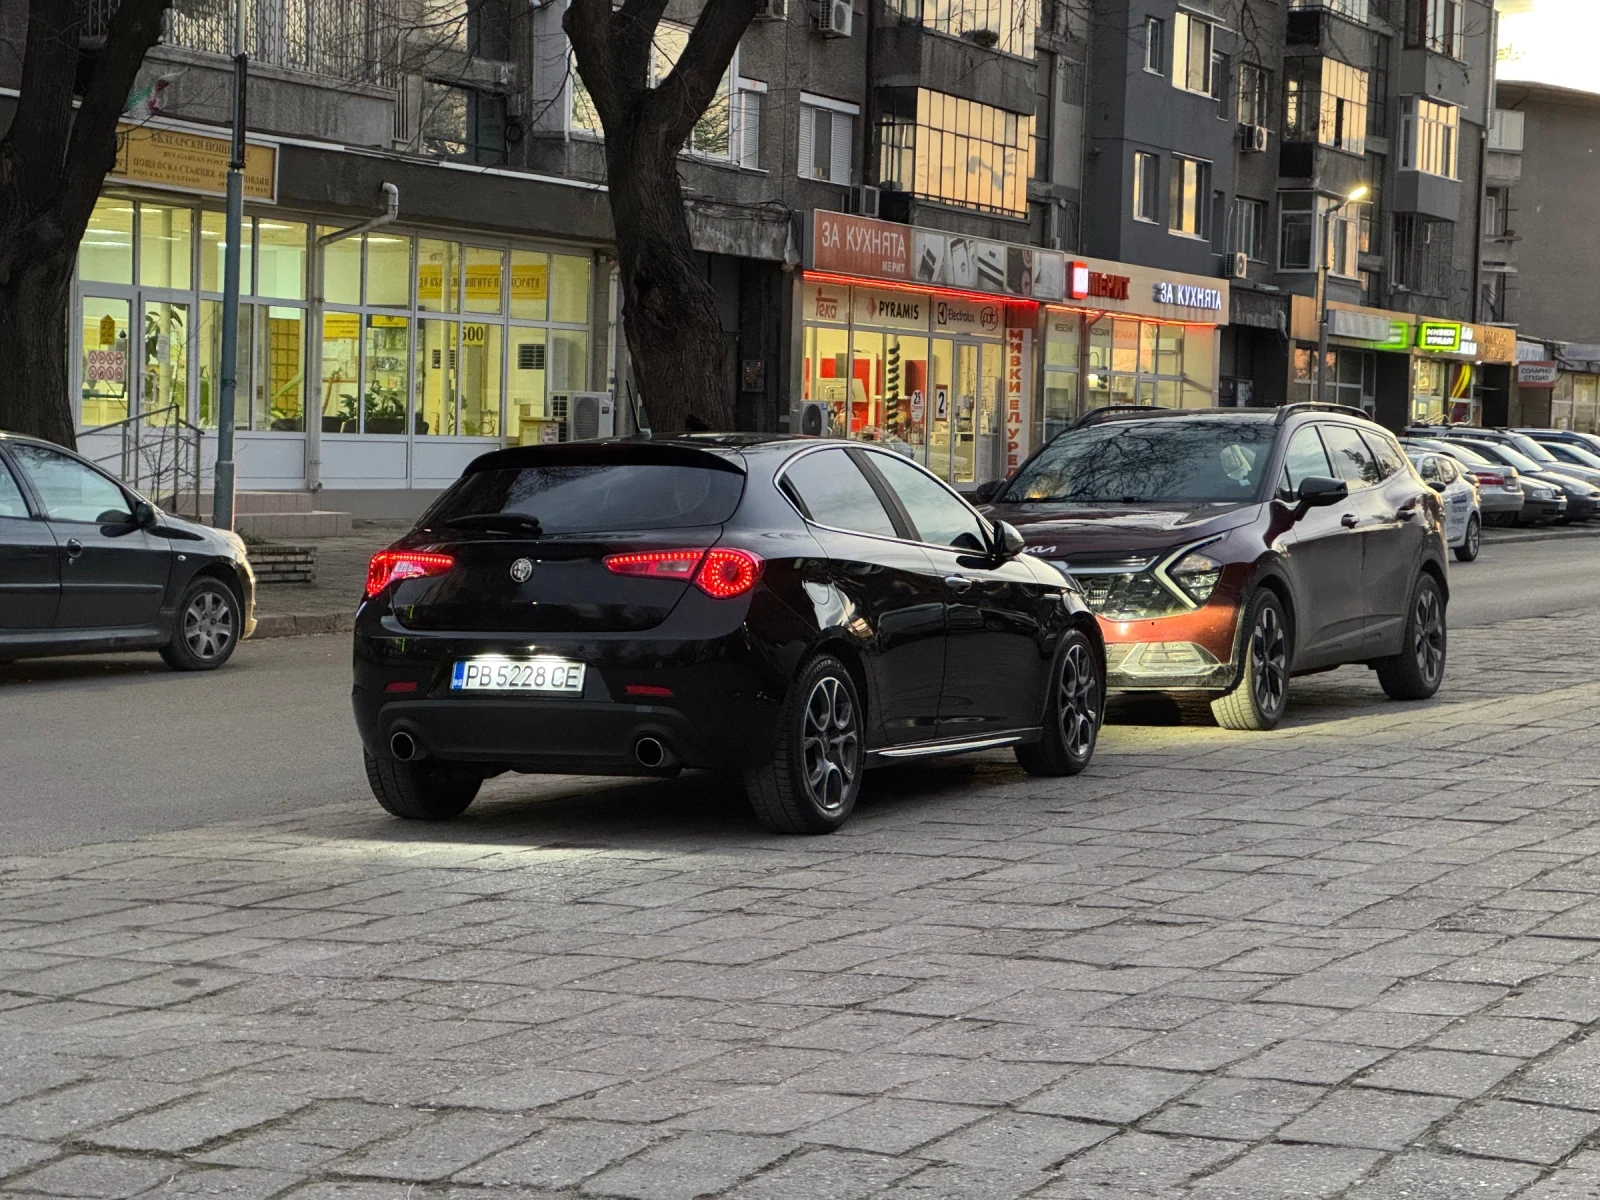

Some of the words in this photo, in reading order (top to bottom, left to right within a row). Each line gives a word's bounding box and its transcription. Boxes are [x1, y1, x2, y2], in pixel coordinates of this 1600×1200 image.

[821, 221, 840, 249] ЗА
[846, 224, 907, 259] КУХНЯТА
[881, 260, 905, 274] МЕРИТ
[1160, 282, 1174, 305] ЗА
[1177, 284, 1222, 311] КУХНЯТА
[878, 300, 919, 320] PYRAMIS
[948, 307, 976, 324] Electrolux
[1008, 329, 1024, 393] МИВКИ
[1521, 367, 1552, 375] СОЛАРНО
[1523, 374, 1549, 382] СТУДИО
[938, 391, 945, 414] 2
[465, 664, 492, 687] PB
[496, 665, 546, 688] 5228
[550, 665, 581, 688] CE
